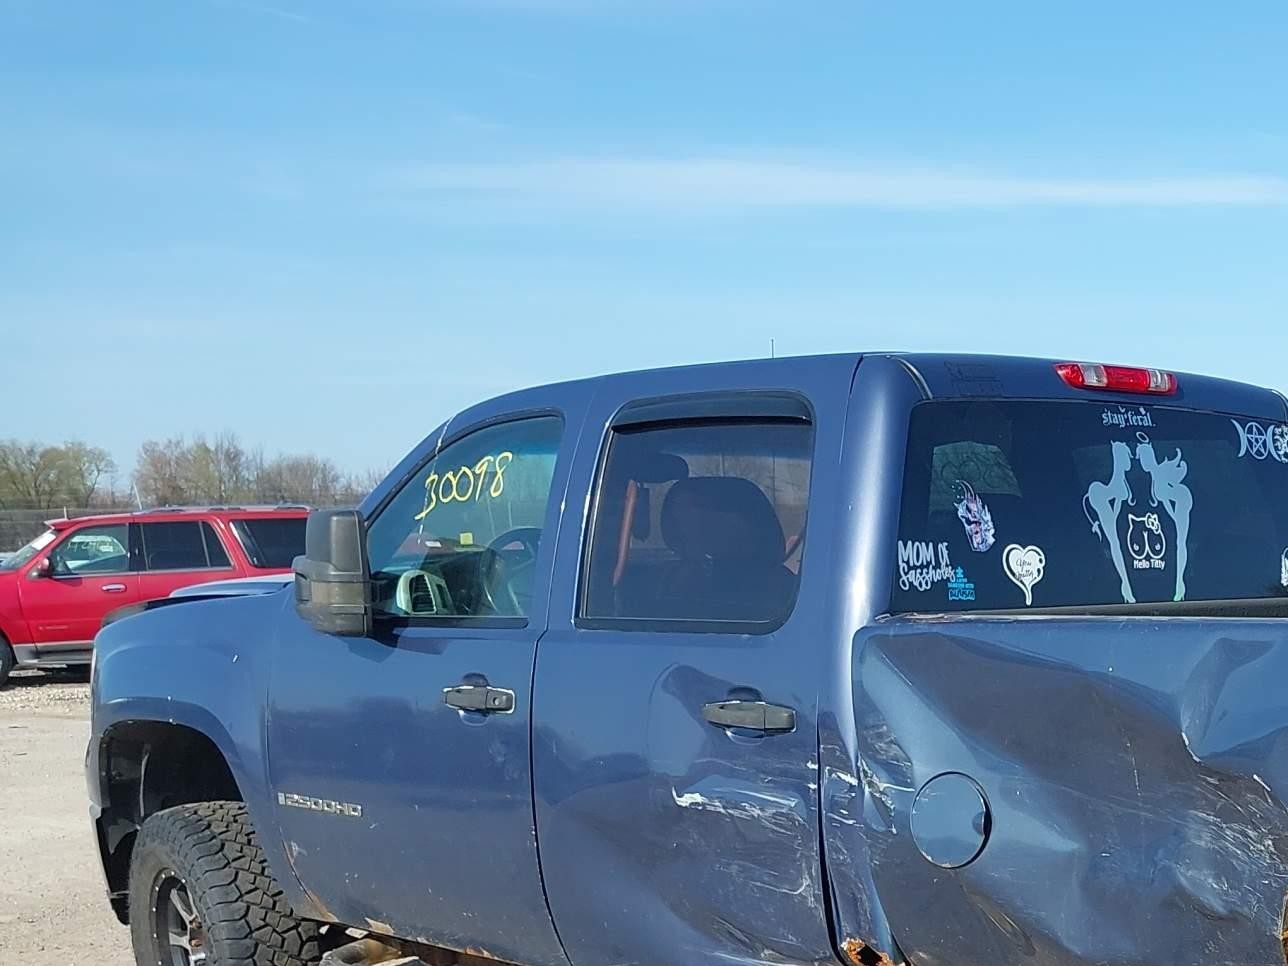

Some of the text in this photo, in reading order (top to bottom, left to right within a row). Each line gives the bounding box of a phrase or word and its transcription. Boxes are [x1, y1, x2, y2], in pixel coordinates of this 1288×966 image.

[415, 452, 513, 520] 30098
[898, 540, 950, 567] MOM OF
[900, 564, 956, 591] Sassholes
[285, 793, 363, 816] 2500HD
